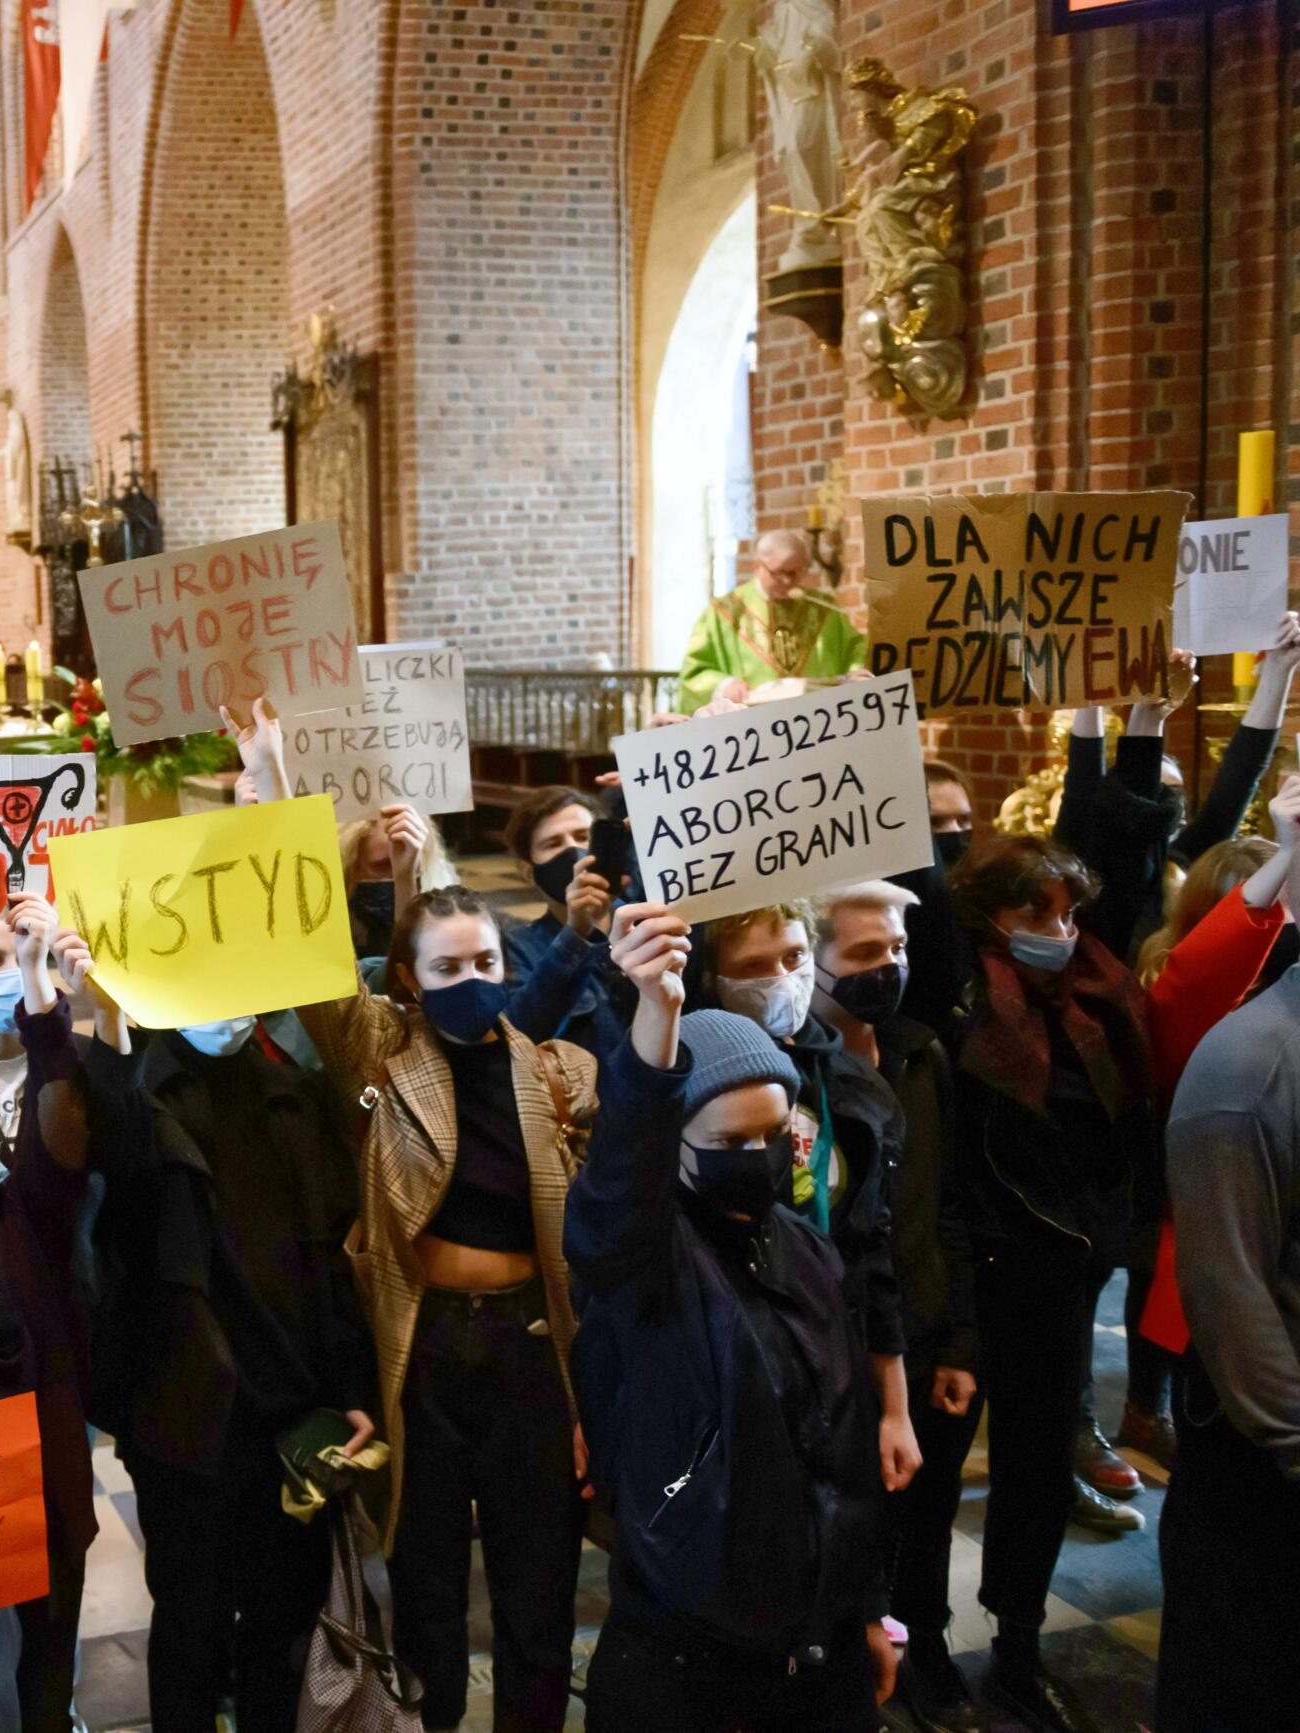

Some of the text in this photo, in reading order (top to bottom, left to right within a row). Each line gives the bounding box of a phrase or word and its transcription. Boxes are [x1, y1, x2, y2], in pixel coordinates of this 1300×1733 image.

[884, 512, 1161, 567] DLA NICH
[1179, 530, 1251, 574] ONIE
[103, 537, 325, 616] CHRONIĘ
[926, 569, 1119, 629] ZAWSZE
[151, 593, 300, 661] MOJE
[1083, 619, 1169, 700] EWA
[123, 625, 353, 727] SIOSTRY
[366, 653, 453, 682] LICZKI
[281, 718, 466, 754] OTRZEBUJĄ
[293, 761, 447, 806] ABORCJI
[646, 763, 865, 858] ABORCJA
[657, 796, 906, 902] BEZ GRANIC
[68, 849, 332, 973] WSTYD
